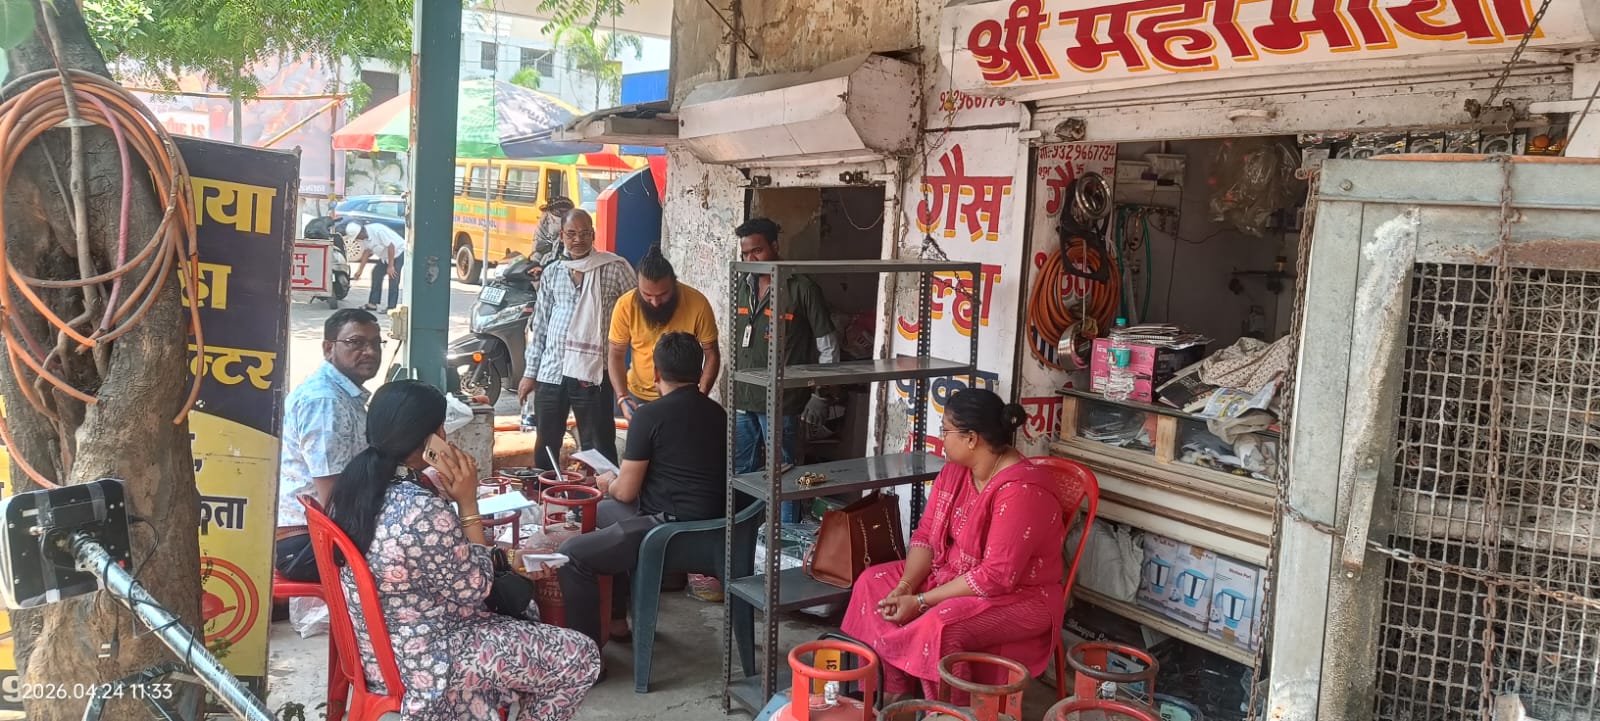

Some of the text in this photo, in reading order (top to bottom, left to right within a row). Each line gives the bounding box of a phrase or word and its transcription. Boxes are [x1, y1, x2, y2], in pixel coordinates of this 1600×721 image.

[967, 0, 1058, 85] श्री
[916, 143, 1013, 241] गैस
[188, 343, 277, 390] न्टर
[826, 659, 837, 670] 31
